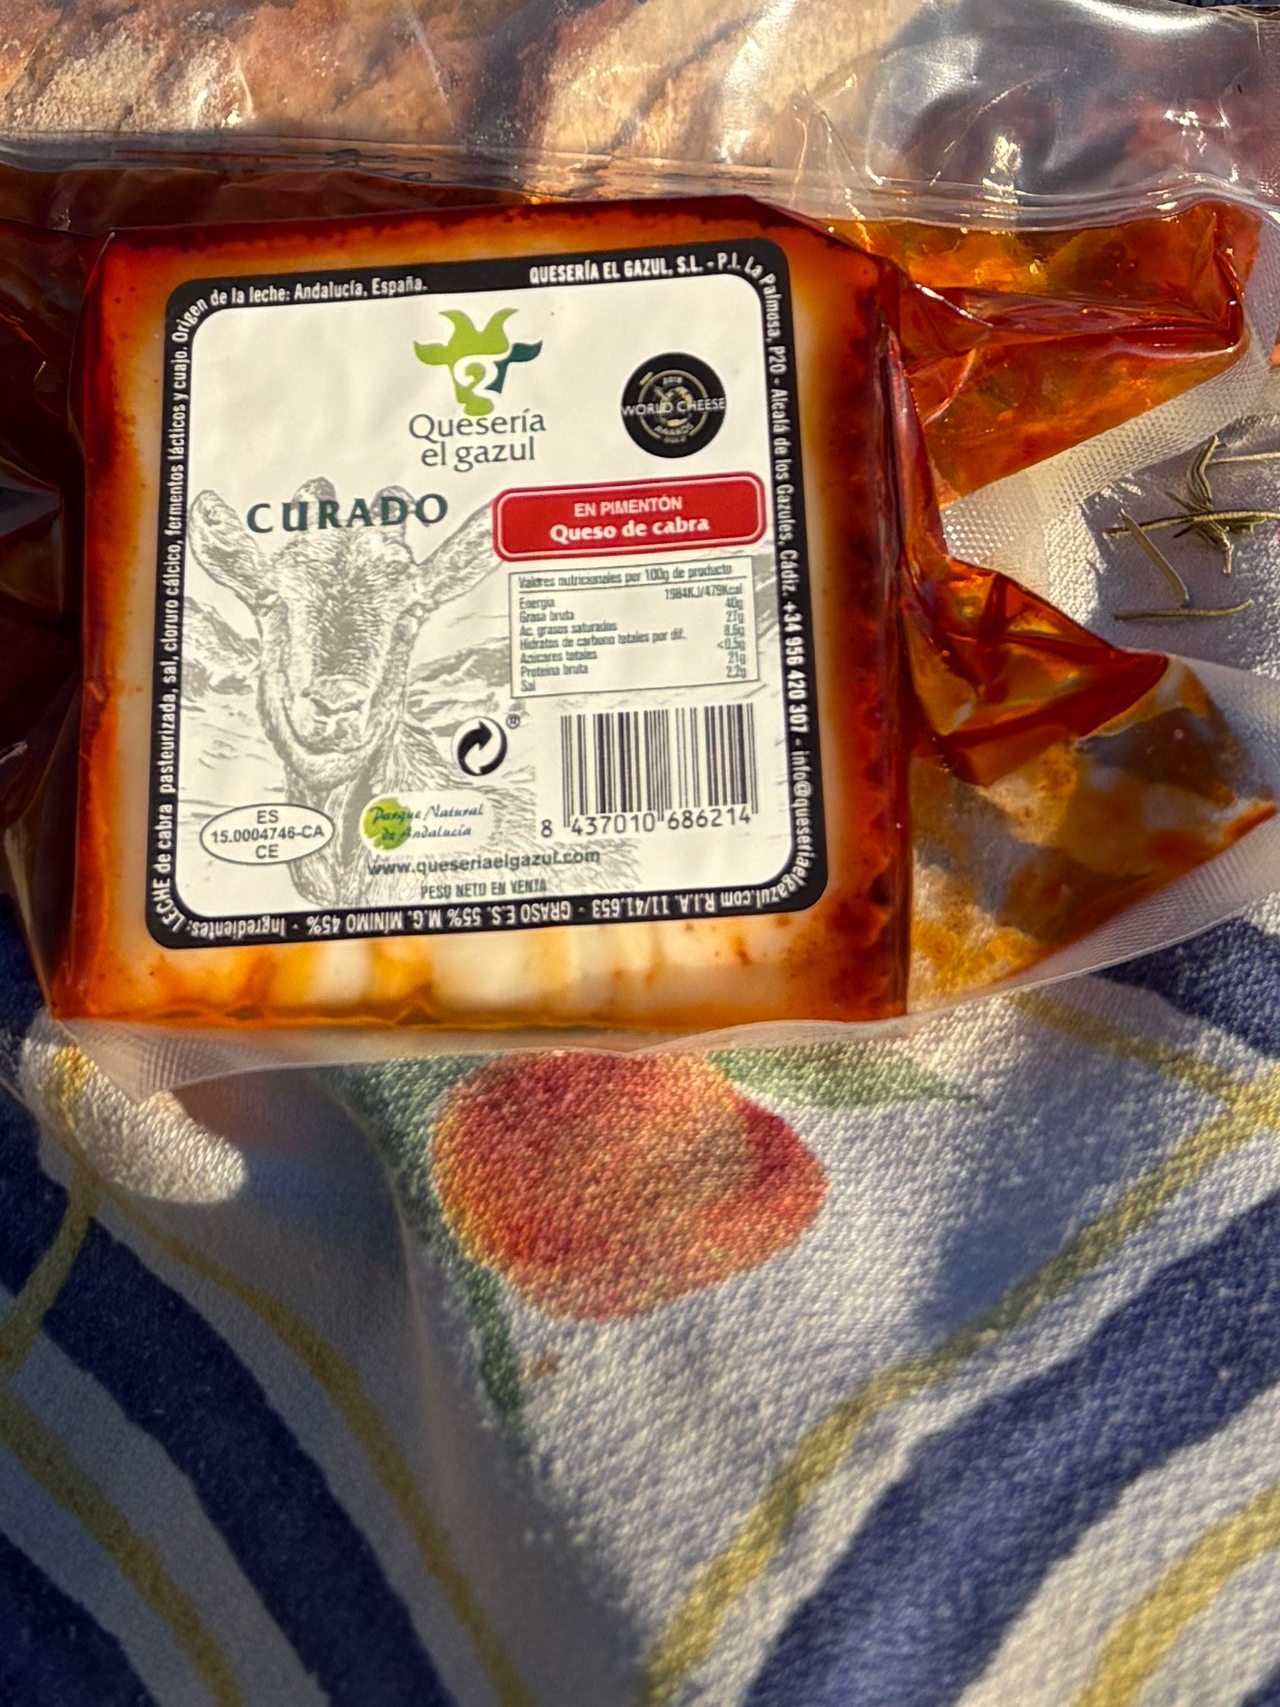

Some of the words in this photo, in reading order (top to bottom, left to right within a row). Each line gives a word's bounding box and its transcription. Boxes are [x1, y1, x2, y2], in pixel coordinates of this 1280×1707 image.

[528, 260, 600, 285] QUESERÍA
[602, 261, 620, 280] EL
[744, 256, 763, 279] La
[210, 289, 228, 307] de
[231, 288, 245, 305] la
[249, 286, 290, 304] leche:
[171, 297, 209, 344] Origen
[767, 345, 788, 373] P20
[172, 390, 189, 400] y
[621, 401, 673, 418] WORLD
[676, 396, 727, 413] CHEESE
[771, 387, 792, 434] Alcalá
[168, 401, 187, 460] lácticos
[408, 408, 548, 441] Quesería
[421, 443, 447, 468] el
[453, 437, 537, 474] gazul
[773, 436, 792, 456] de
[775, 458, 793, 482] los
[164, 464, 185, 537] fermentos
[246, 492, 450, 534] CURADO
[573, 501, 598, 518] EN
[599, 494, 684, 516] PIMENTÓN
[549, 522, 618, 544] Queso
[621, 520, 649, 539] de
[651, 516, 710, 536] cabra
[163, 598, 180, 652] cloruro
[783, 601, 803, 633] +34
[784, 636, 805, 666] 956
[786, 669, 808, 700] 420
[788, 702, 810, 734] 307
[157, 688, 180, 794] pasteurizada,
[256, 809, 280, 825] ES
[422, 803, 485, 821] Natural
[541, 819, 554, 838] 8
[571, 812, 656, 837] 437010
[667, 805, 751, 830] 686214
[154, 803, 173, 851] cabra
[210, 825, 325, 844] 15.0004746-CA
[153, 854, 171, 872] de
[255, 844, 280, 860] CE
[368, 849, 601, 877] www.queseriaelgazul.com
[510, 878, 547, 894] VENTA
[151, 877, 187, 933] LECHE
[447, 905, 482, 928] 55%
[520, 900, 571, 923] GRASO
[186, 914, 286, 940] Ingredientes:
[306, 914, 340, 935] 45%
